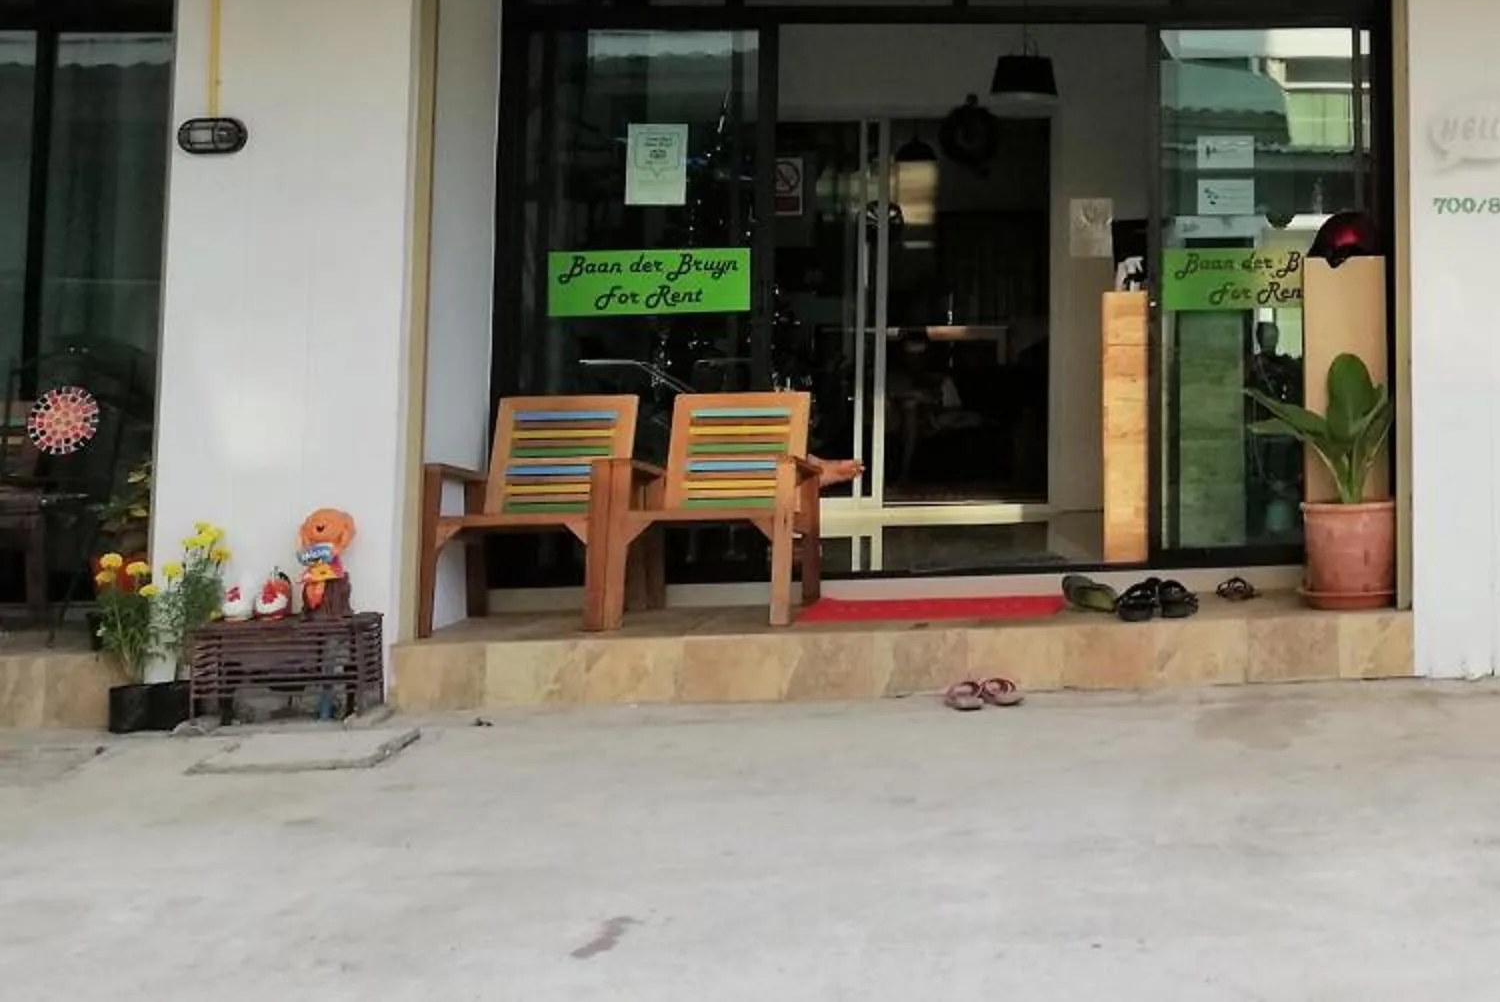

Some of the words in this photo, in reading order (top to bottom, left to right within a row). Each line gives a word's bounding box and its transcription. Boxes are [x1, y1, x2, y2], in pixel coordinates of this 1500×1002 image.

[557, 254, 624, 285] Baan
[628, 254, 664, 274] der
[665, 253, 739, 282] Bruyn
[1173, 252, 1234, 280] Baan
[1240, 250, 1273, 272] der
[593, 285, 640, 310] For
[644, 285, 704, 309] Rent
[1208, 282, 1253, 306] For
[1256, 281, 1303, 305] Ren
